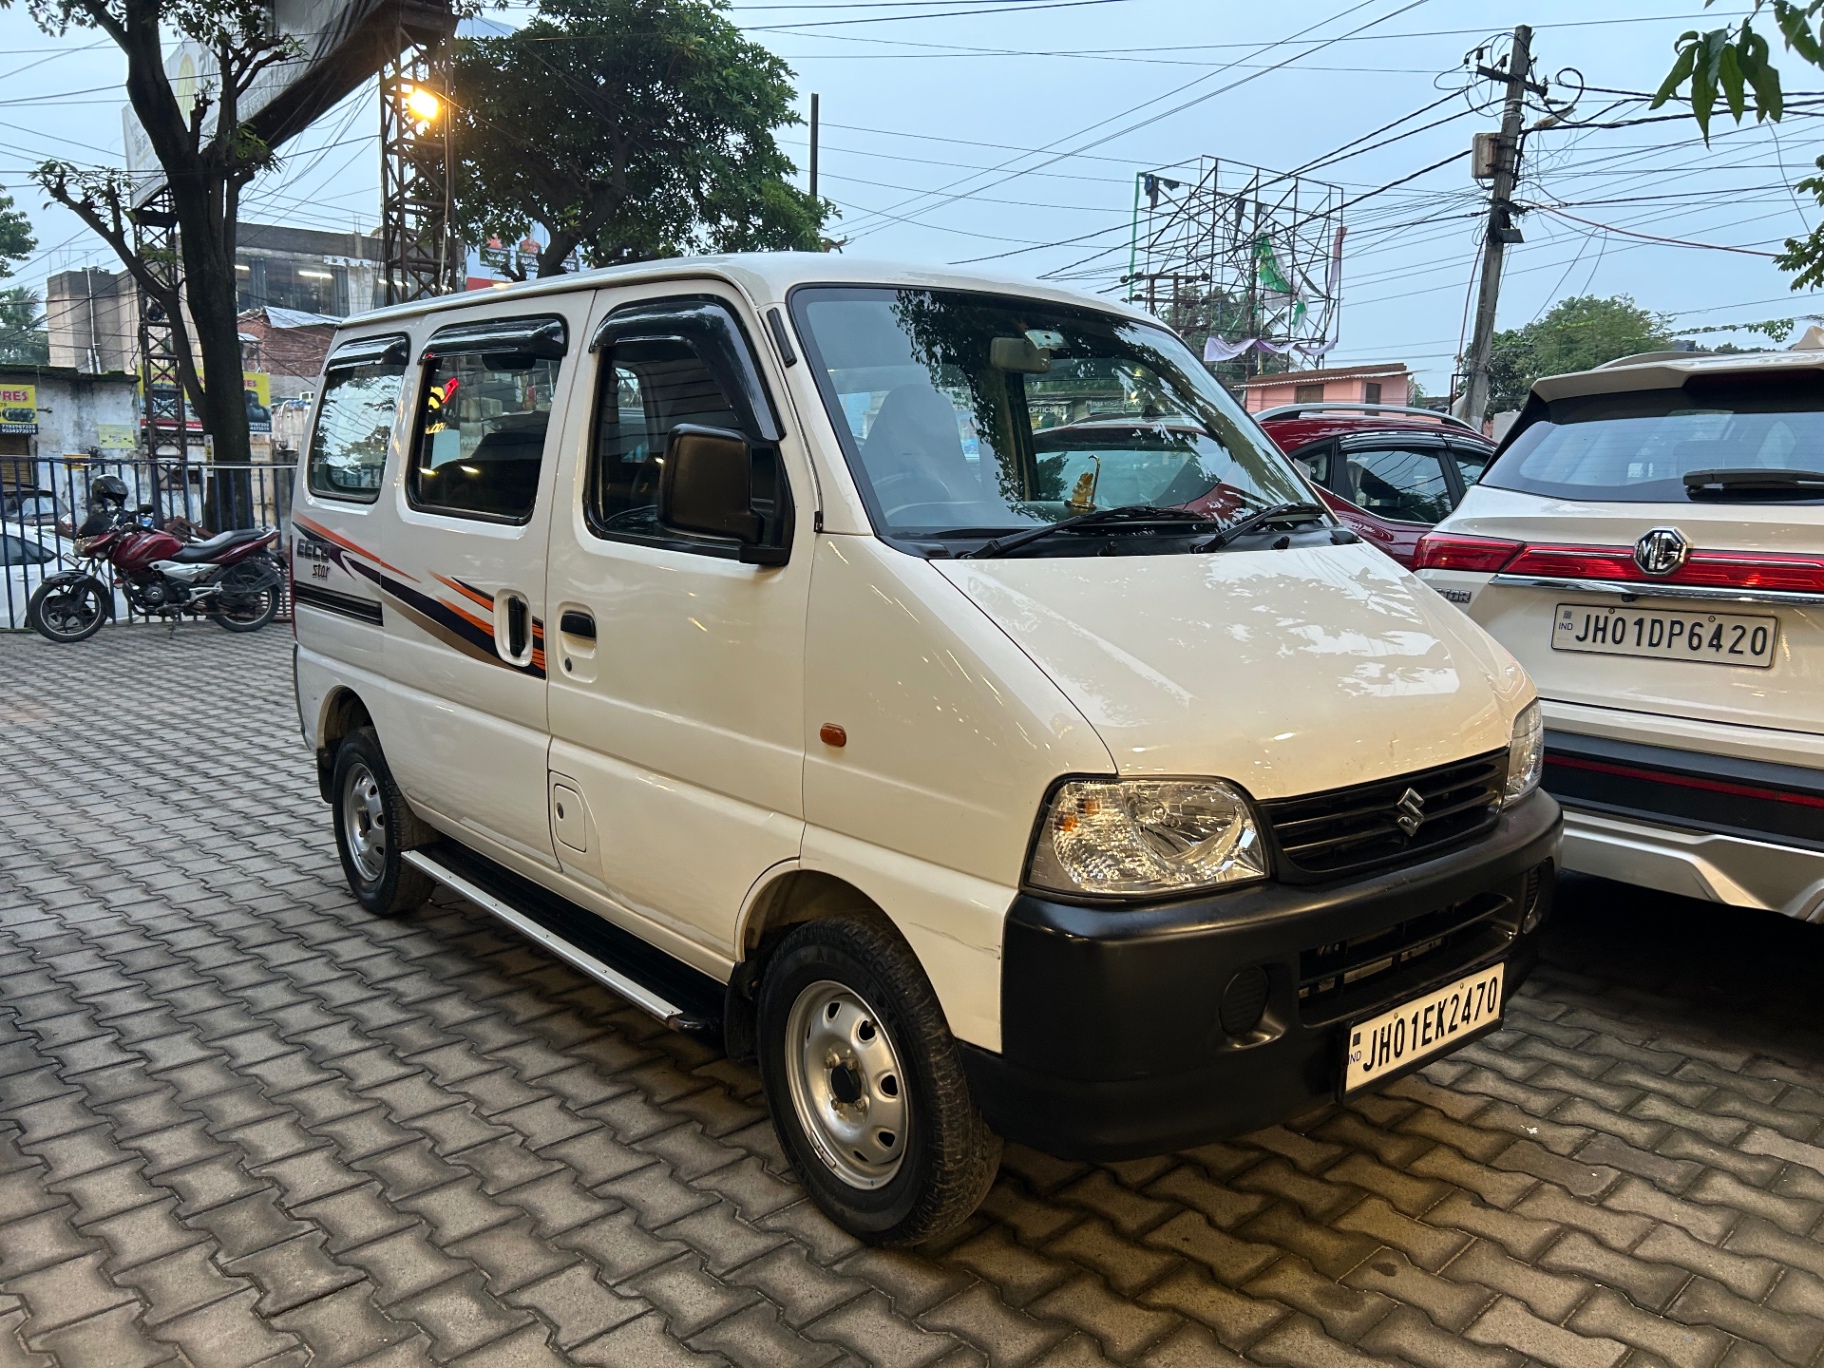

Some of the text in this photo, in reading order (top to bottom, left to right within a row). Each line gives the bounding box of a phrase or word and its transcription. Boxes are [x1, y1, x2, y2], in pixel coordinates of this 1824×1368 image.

[297, 538, 330, 563] EECO
[1558, 614, 1768, 656] IND JH01DP6420
[1363, 976, 1498, 1072] JH01EK2470
